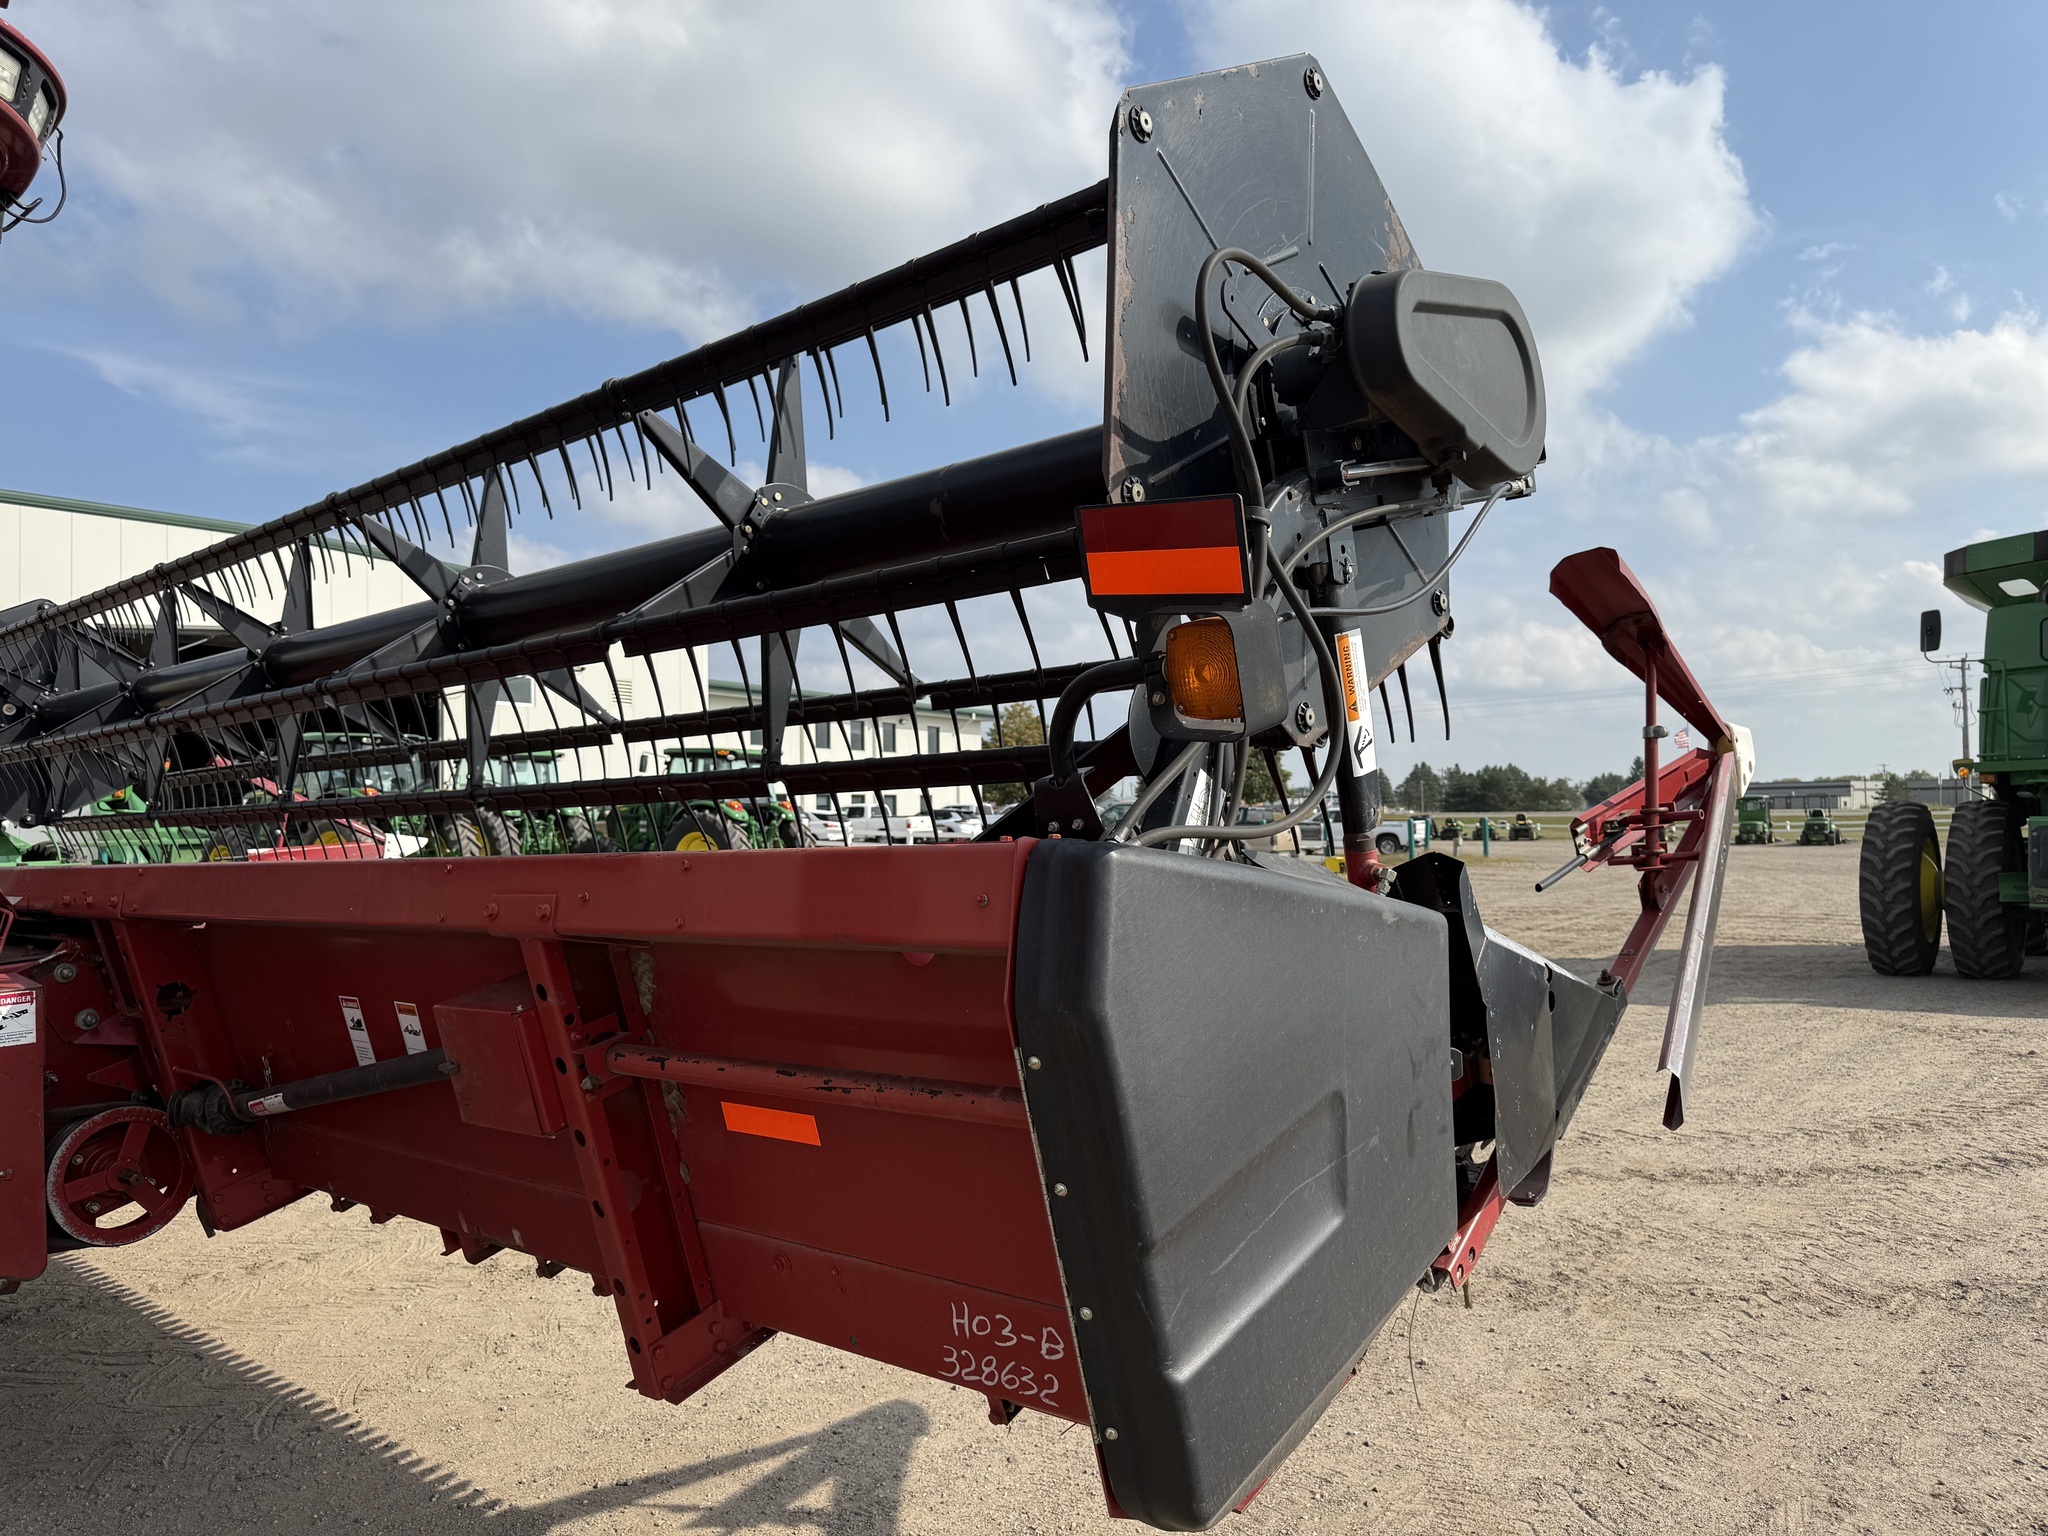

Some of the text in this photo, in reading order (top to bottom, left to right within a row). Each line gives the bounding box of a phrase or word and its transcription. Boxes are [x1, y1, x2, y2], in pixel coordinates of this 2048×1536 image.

[1342, 645, 1356, 696] WARNING
[0, 995, 31, 1005] DANGER
[937, 1345, 1060, 1408] 328632
